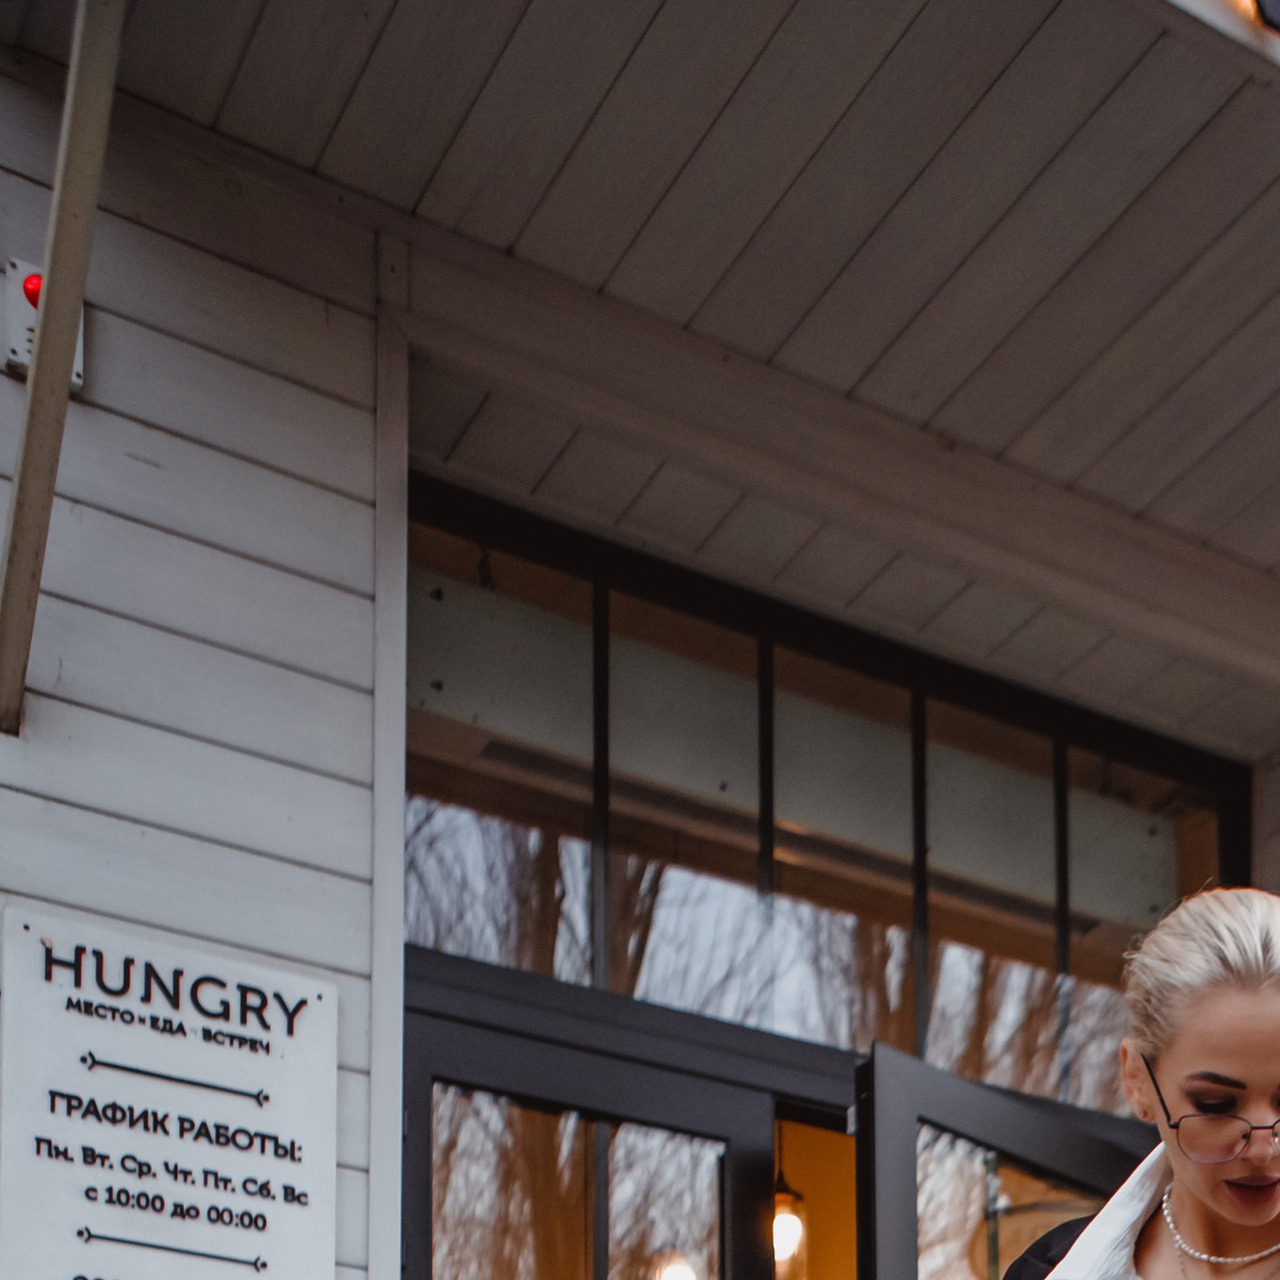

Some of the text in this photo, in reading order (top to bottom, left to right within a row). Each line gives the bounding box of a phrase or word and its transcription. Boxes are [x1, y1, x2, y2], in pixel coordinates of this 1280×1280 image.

[42, 941, 308, 1037] HUNGRY
[65, 996, 135, 1025] МЕСТО
[150, 1015, 187, 1038] ЕДА
[49, 1090, 303, 1163] ГРАФИК РАБОТЫ:
[35, 1136, 309, 1207] Пн. Вт. Ср. Чт. Пт. Сб. Вс
[84, 1186, 268, 1231] с 10:00 до 00:00
